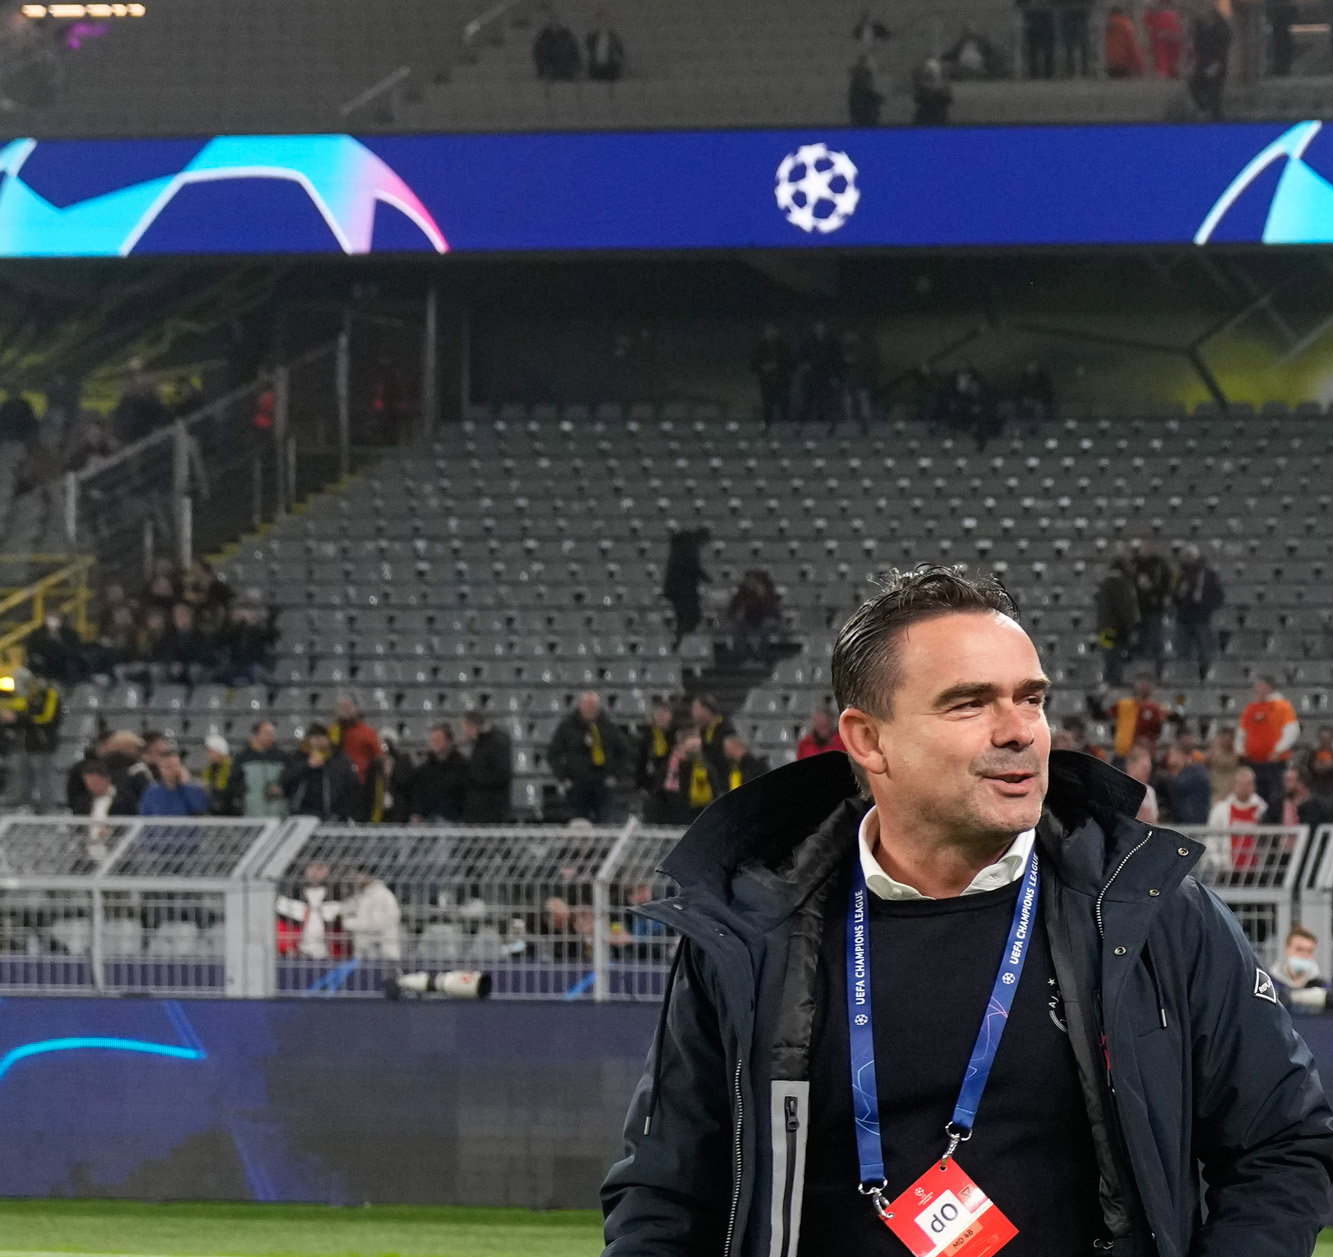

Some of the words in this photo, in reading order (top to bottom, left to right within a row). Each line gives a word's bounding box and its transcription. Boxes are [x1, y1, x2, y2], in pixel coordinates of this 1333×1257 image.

[855, 889, 864, 923] LEAGUE
[1009, 940, 1023, 965] UEFA
[1016, 888, 1035, 939] CHAMPIONS
[855, 925, 865, 978] CHAMPIONS
[856, 980, 865, 1005] UEFA
[953, 1236, 965, 1248] MD
[964, 1229, 974, 1238] 4B
